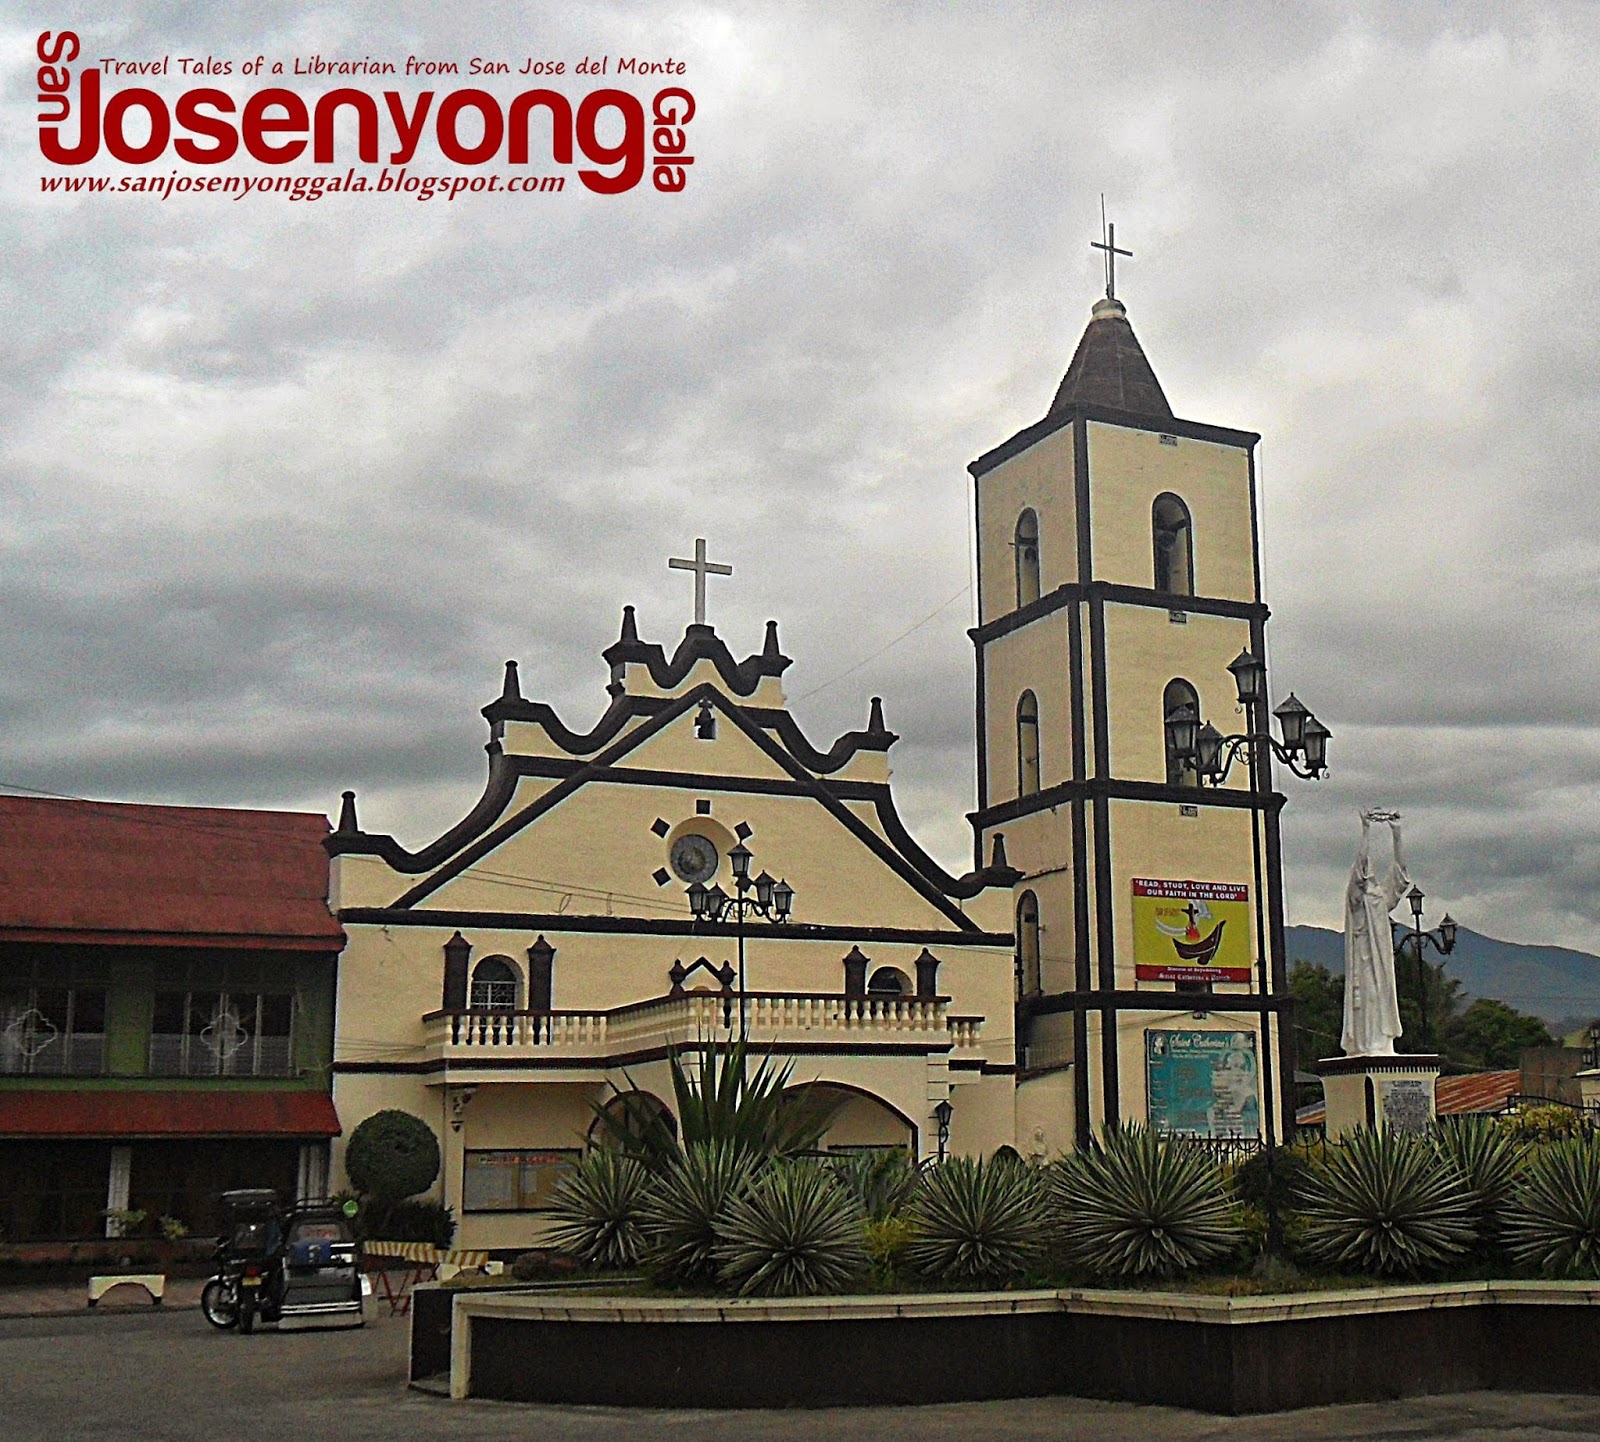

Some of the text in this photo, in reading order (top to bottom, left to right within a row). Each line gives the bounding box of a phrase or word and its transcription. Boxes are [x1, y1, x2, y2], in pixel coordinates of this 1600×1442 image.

[1191, 883, 1210, 891] LOVE
[1229, 885, 1246, 893] LIVE
[1146, 888, 1163, 896] OUR
[1199, 891, 1213, 899] THE
